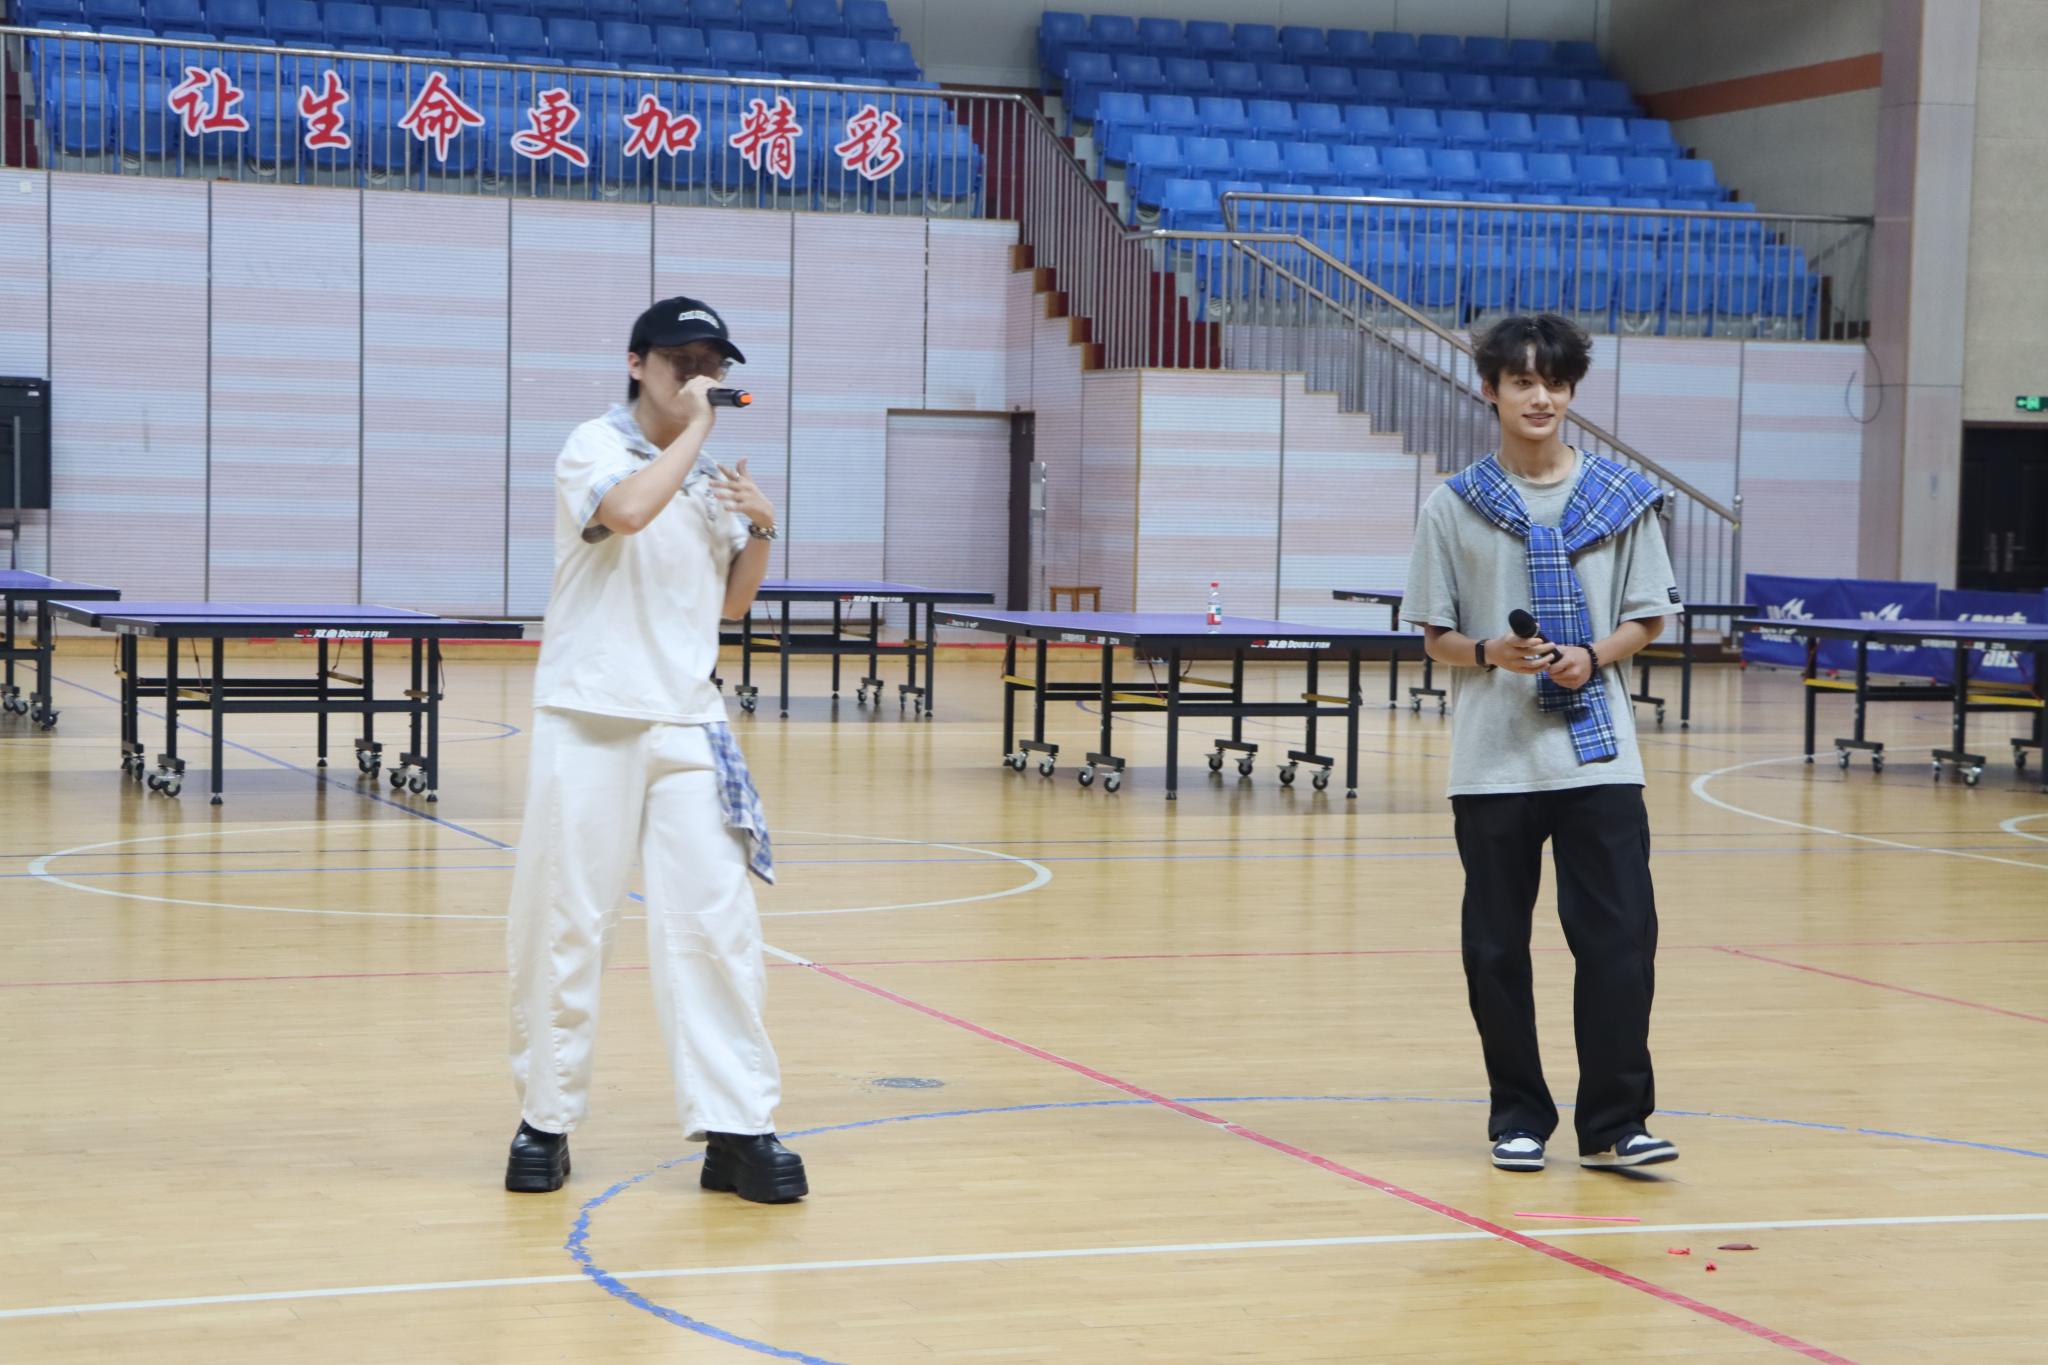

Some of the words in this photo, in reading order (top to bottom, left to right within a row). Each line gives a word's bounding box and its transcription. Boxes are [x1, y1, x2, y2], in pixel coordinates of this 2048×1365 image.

[169, 65, 905, 181] 让生命更加精彩
